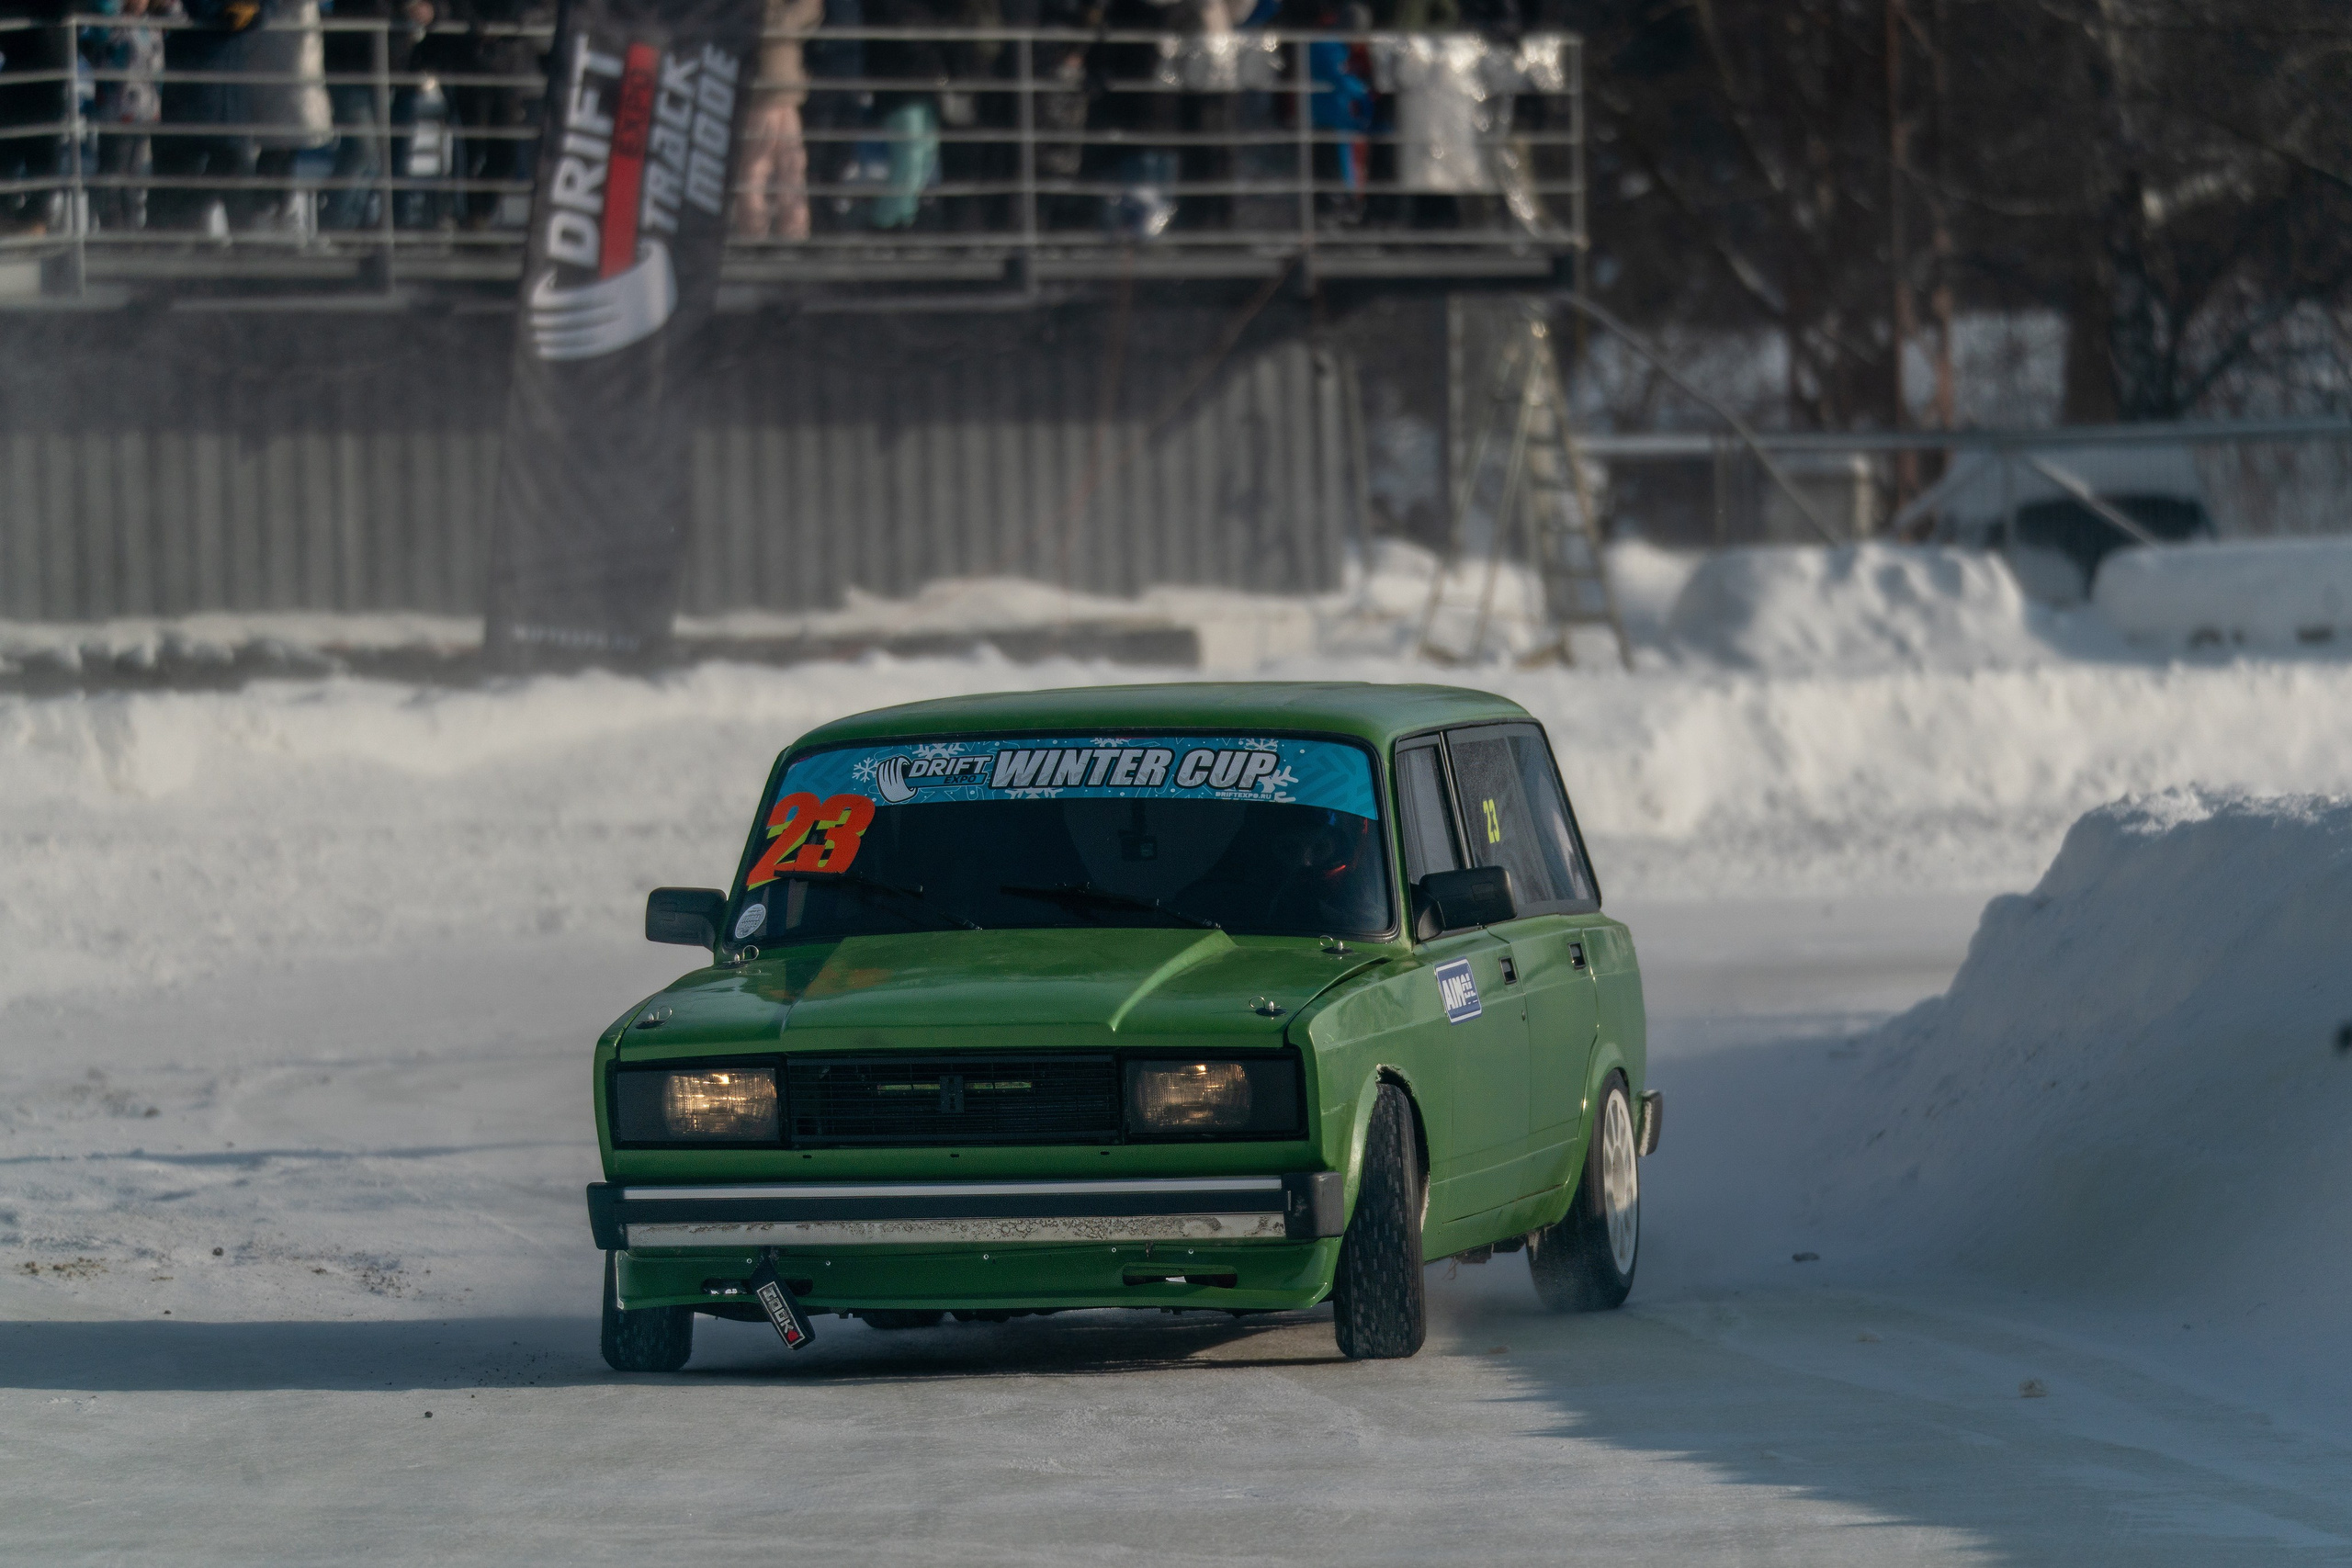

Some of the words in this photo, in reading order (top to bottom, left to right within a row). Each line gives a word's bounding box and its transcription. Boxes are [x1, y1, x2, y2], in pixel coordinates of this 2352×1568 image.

[546, 33, 625, 268] DRIFT
[909, 755, 992, 778] DRIFT
[943, 774, 977, 784] EXPO
[990, 749, 1173, 788] WINTER
[1176, 750, 1277, 789] CUP
[746, 792, 876, 890] 23
[1483, 799, 1500, 843] 23
